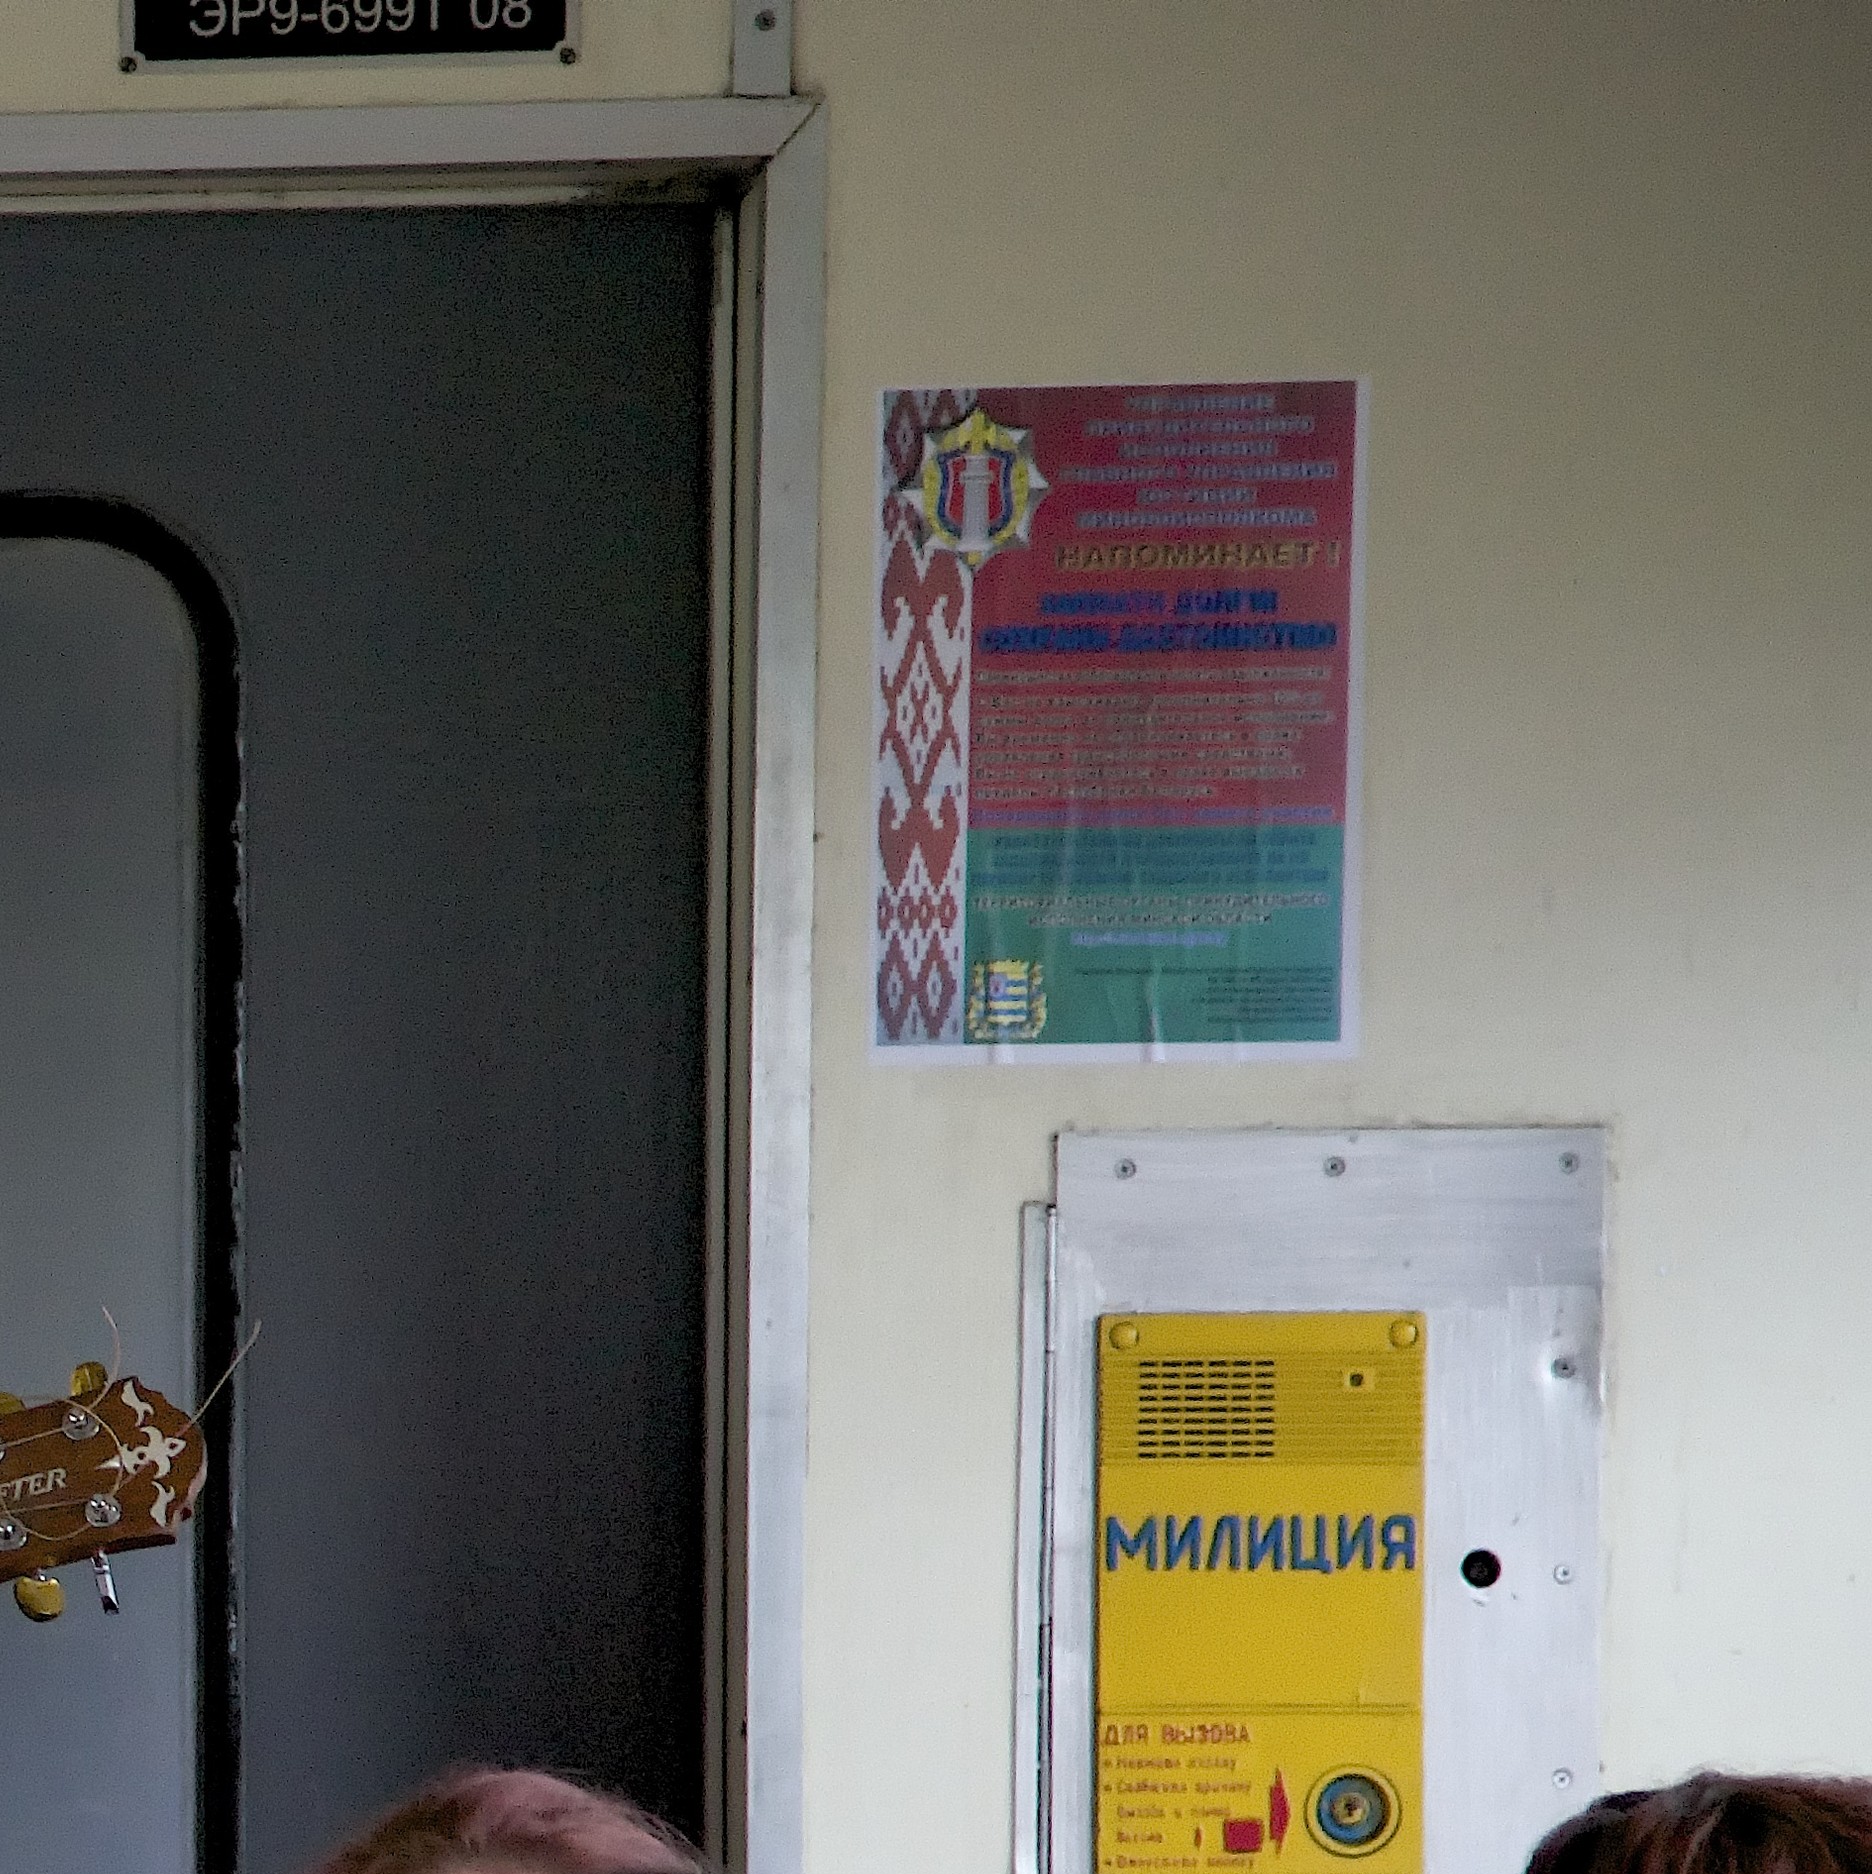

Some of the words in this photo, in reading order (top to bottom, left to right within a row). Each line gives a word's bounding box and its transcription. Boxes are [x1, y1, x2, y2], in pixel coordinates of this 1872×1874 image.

[469, 0, 533, 30] 08
[1055, 540, 1315, 570] НАПОМИНАЕТ
[1105, 1512, 1418, 1574] МИЛИЦИЯ
[1104, 1723, 1149, 1746] ДЛЯ
[1161, 1723, 1251, 1745] ВЫЗОВА
